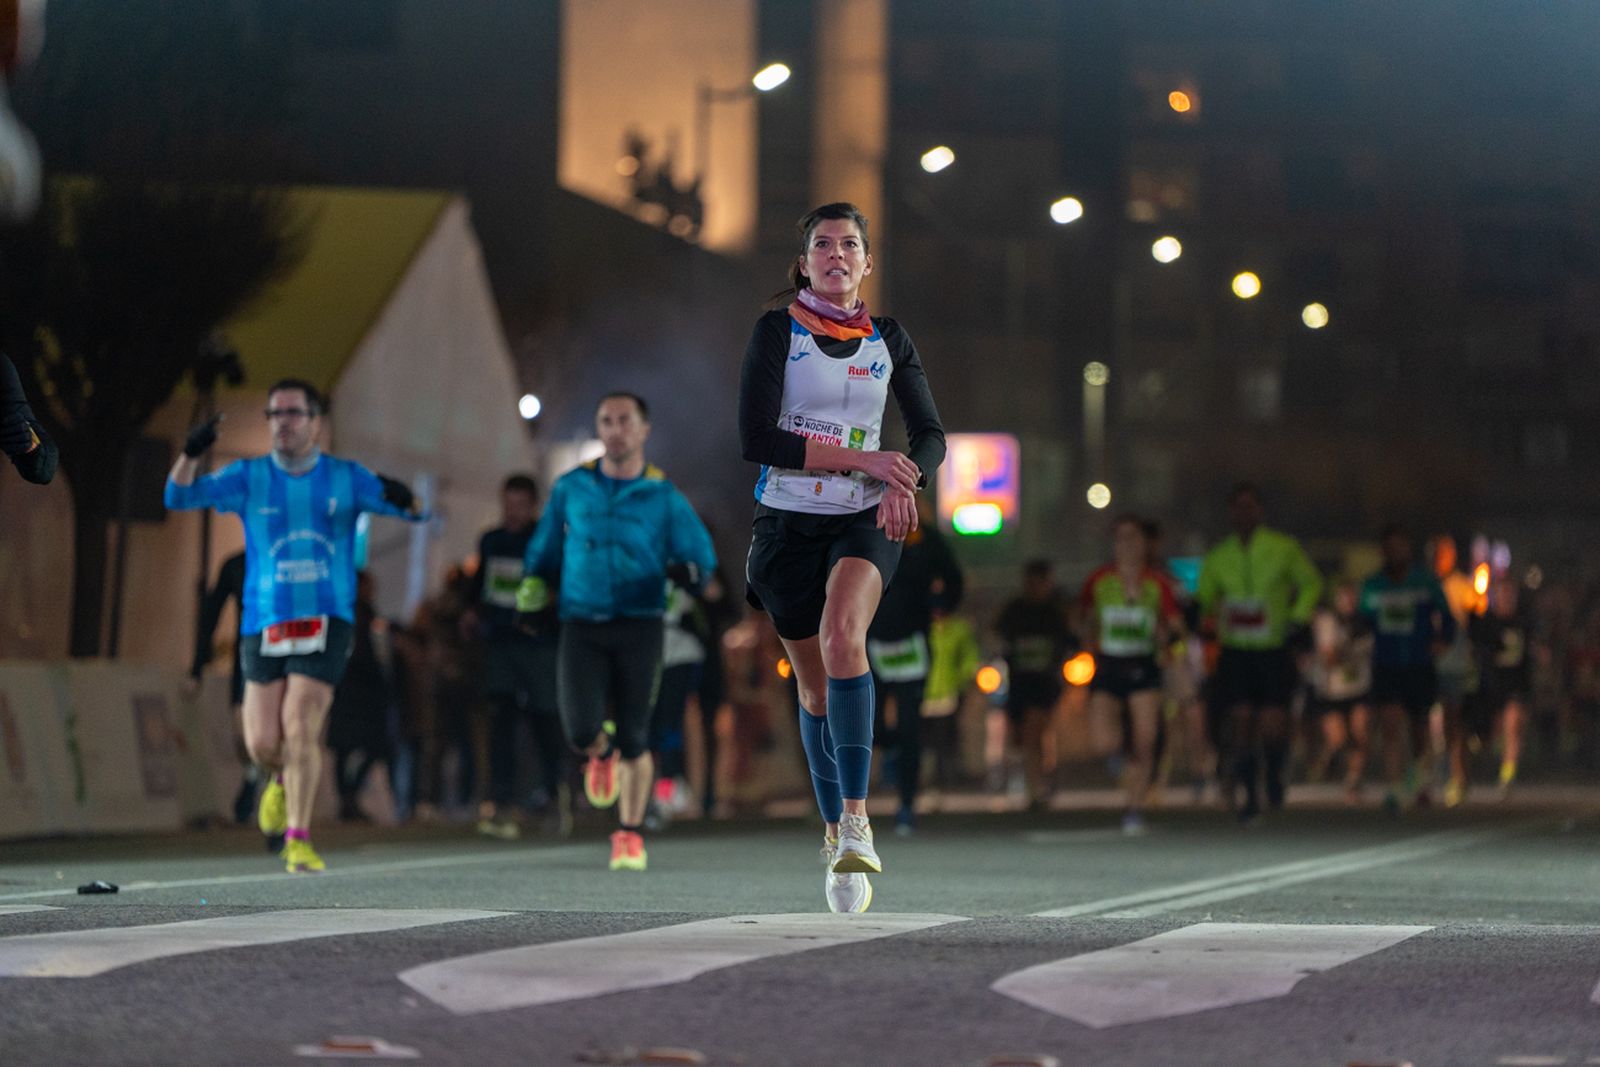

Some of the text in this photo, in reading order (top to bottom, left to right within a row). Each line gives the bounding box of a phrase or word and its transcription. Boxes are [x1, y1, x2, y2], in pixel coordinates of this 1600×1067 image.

[848, 366, 869, 376] Run
[804, 421, 832, 434] NOCHE
[832, 426, 844, 436] DE
